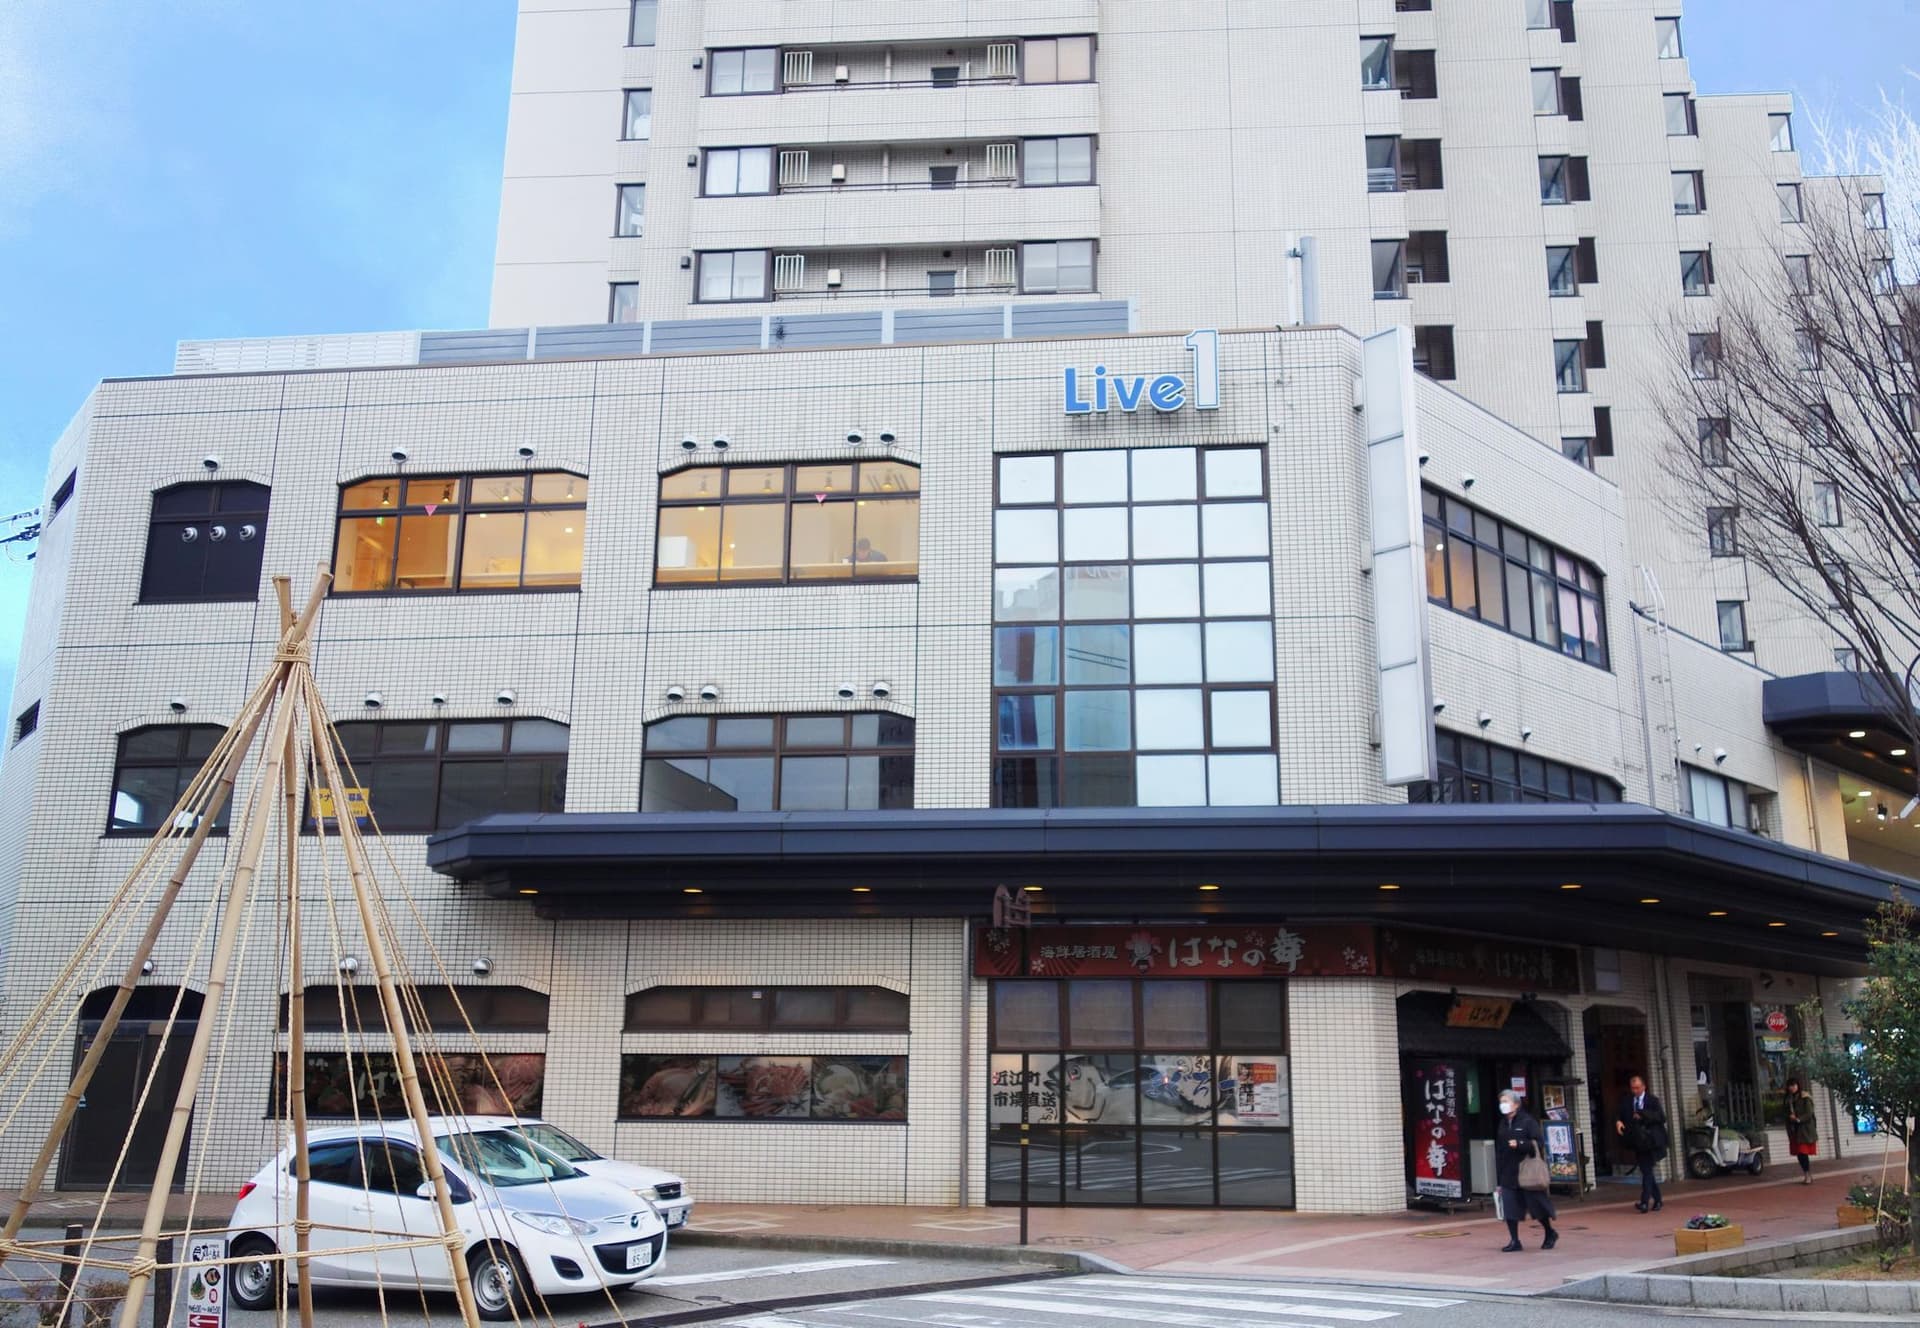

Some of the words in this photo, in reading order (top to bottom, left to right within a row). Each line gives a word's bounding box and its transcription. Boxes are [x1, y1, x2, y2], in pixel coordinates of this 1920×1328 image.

[1040, 945, 1119, 960] 海鮮居酒屋
[1169, 928, 1306, 973] はなの舞
[1424, 1079, 1449, 1177] はなの舞
